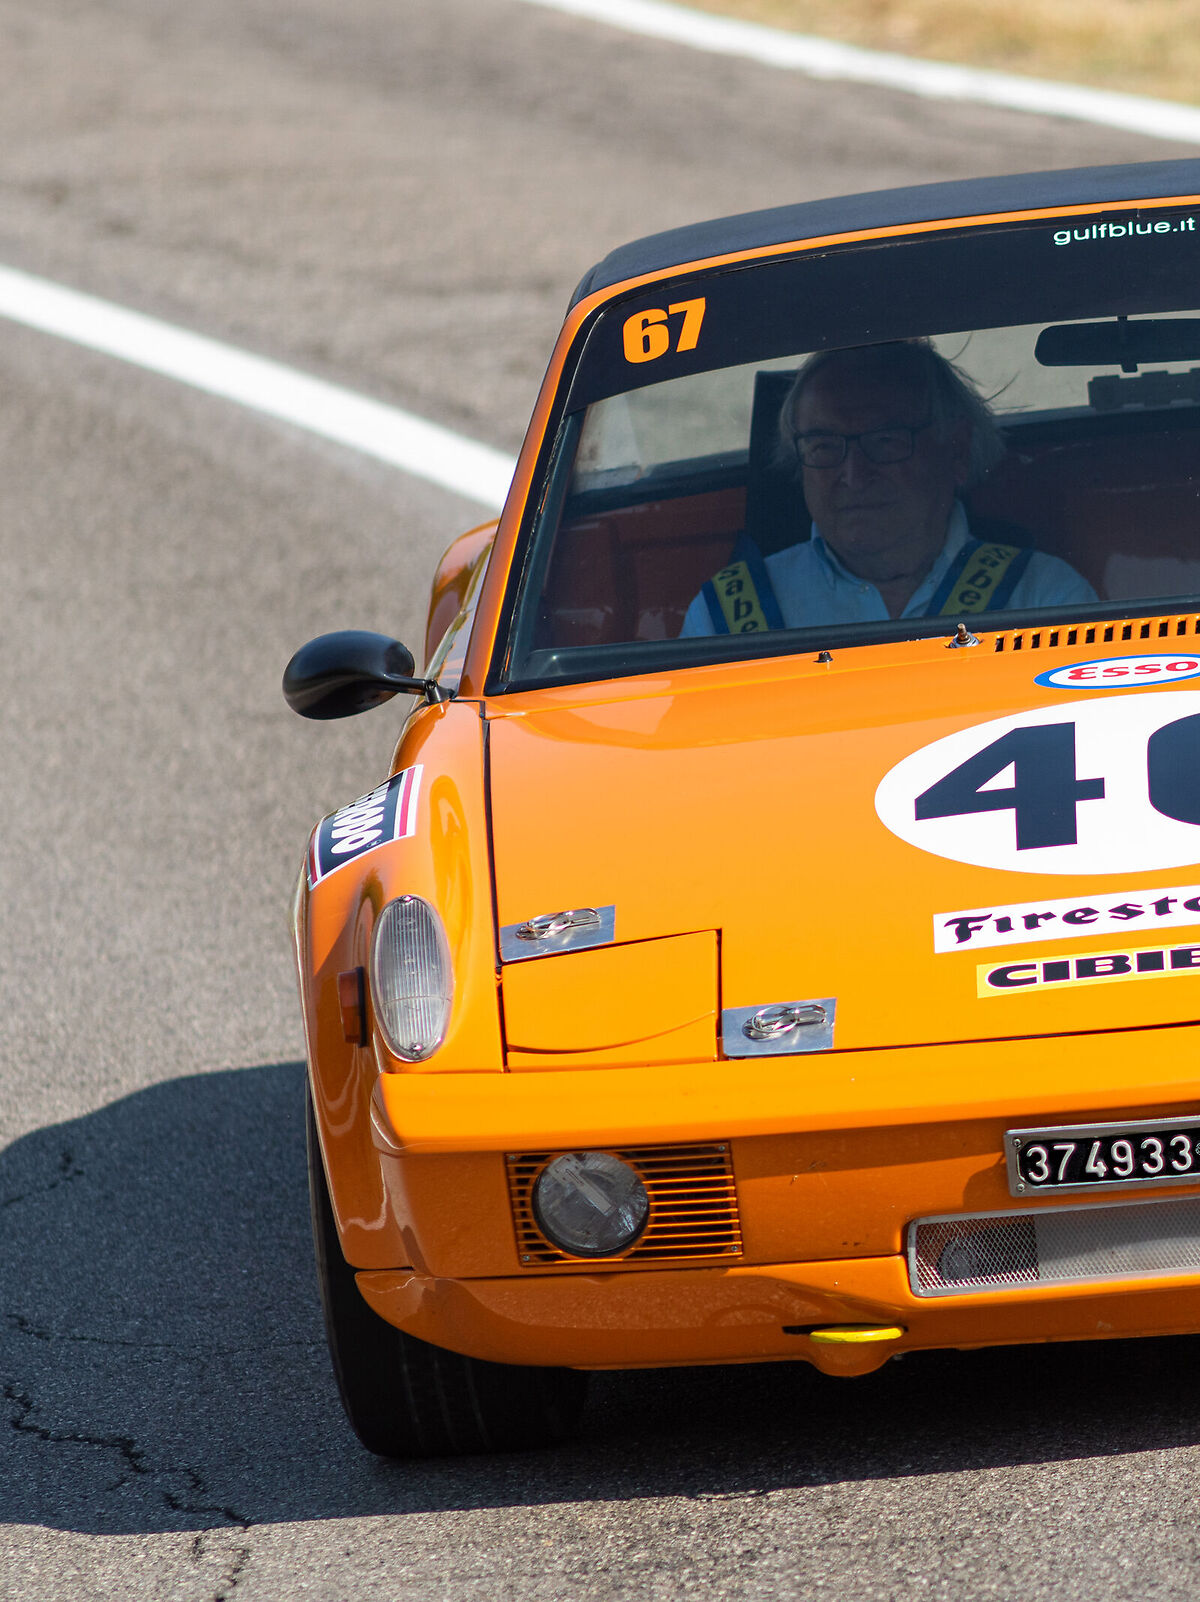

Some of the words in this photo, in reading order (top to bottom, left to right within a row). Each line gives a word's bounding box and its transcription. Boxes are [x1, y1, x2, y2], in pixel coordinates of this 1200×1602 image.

[1053, 217, 1197, 246] gulfblue.it
[622, 297, 706, 364] 67
[1026, 1136, 1193, 1183] 374933
